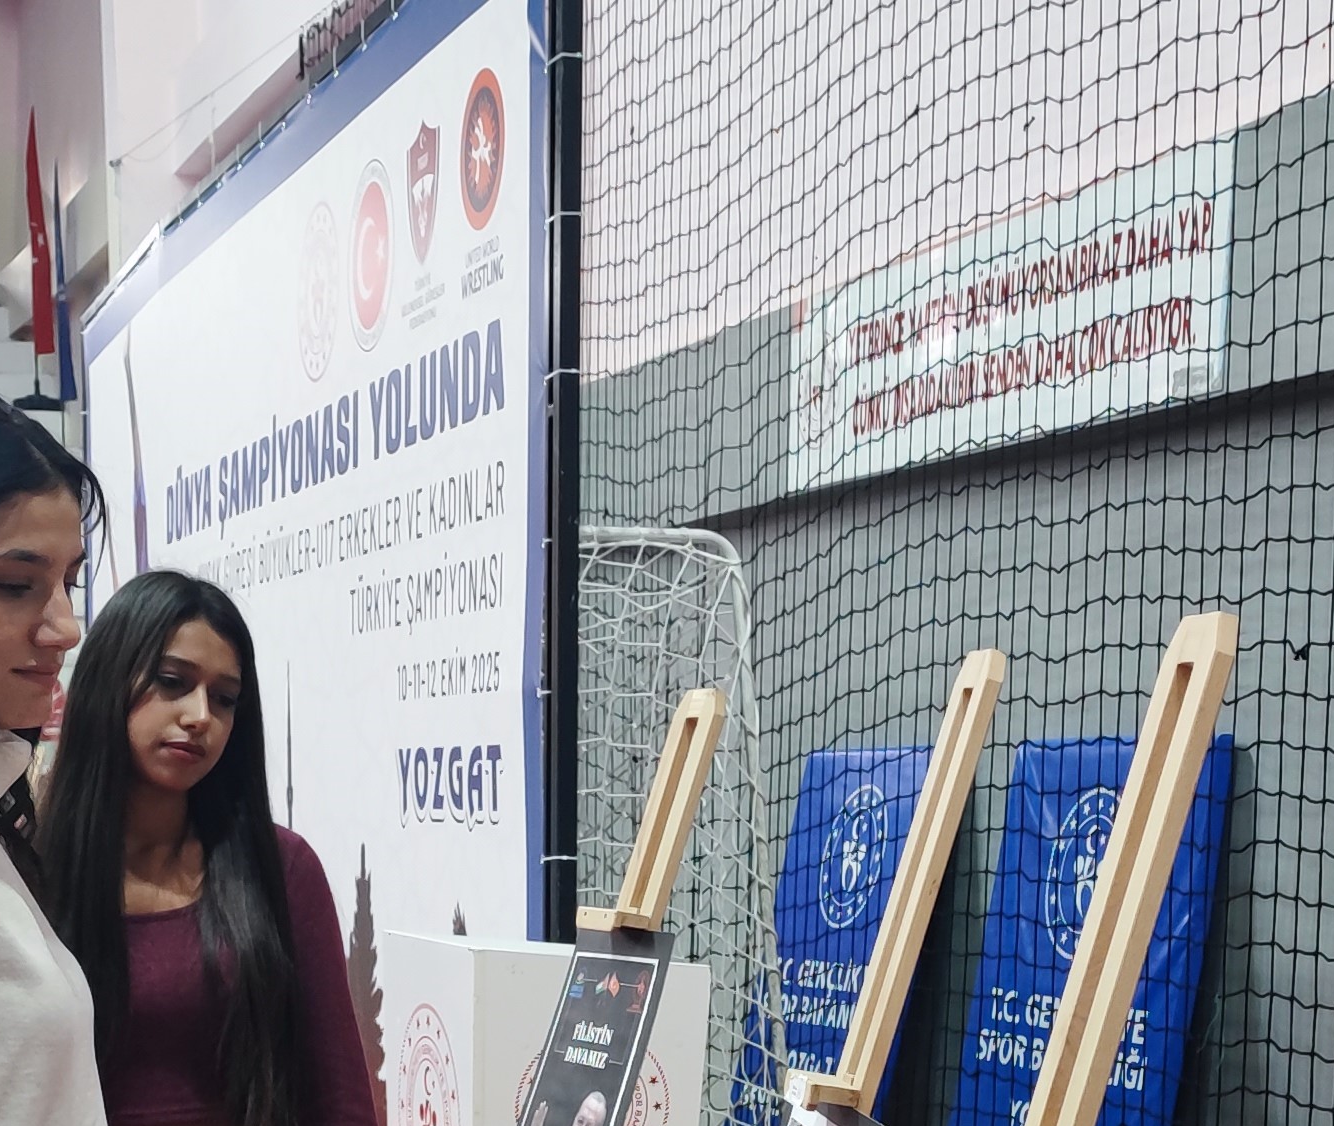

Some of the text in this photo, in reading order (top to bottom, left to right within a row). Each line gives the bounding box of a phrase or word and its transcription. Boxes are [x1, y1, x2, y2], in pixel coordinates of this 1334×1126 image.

[1125, 214, 1173, 278] DAHA
[1178, 201, 1212, 261] YAP
[460, 252, 504, 300] WRESTLING
[1034, 331, 1075, 383] DAHA
[166, 318, 505, 545] DÜNYA ŞAMPİYONASI YOLUNDA
[338, 496, 402, 562] ERKEKLER
[406, 487, 423, 541] VE
[429, 460, 505, 535] KADINLAR
[349, 551, 504, 636] TÜRKİYE ŞAMPİYONASI
[397, 646, 501, 701] 10-11-12 EKİM 2025
[396, 744, 503, 824] YOZGAT
[991, 986, 1020, 1025] T.C.
[563, 1045, 609, 1070] DAVAMIZ
[571, 1019, 615, 1047] FİLİSTİN
[975, 1027, 1026, 1069] SPOR
